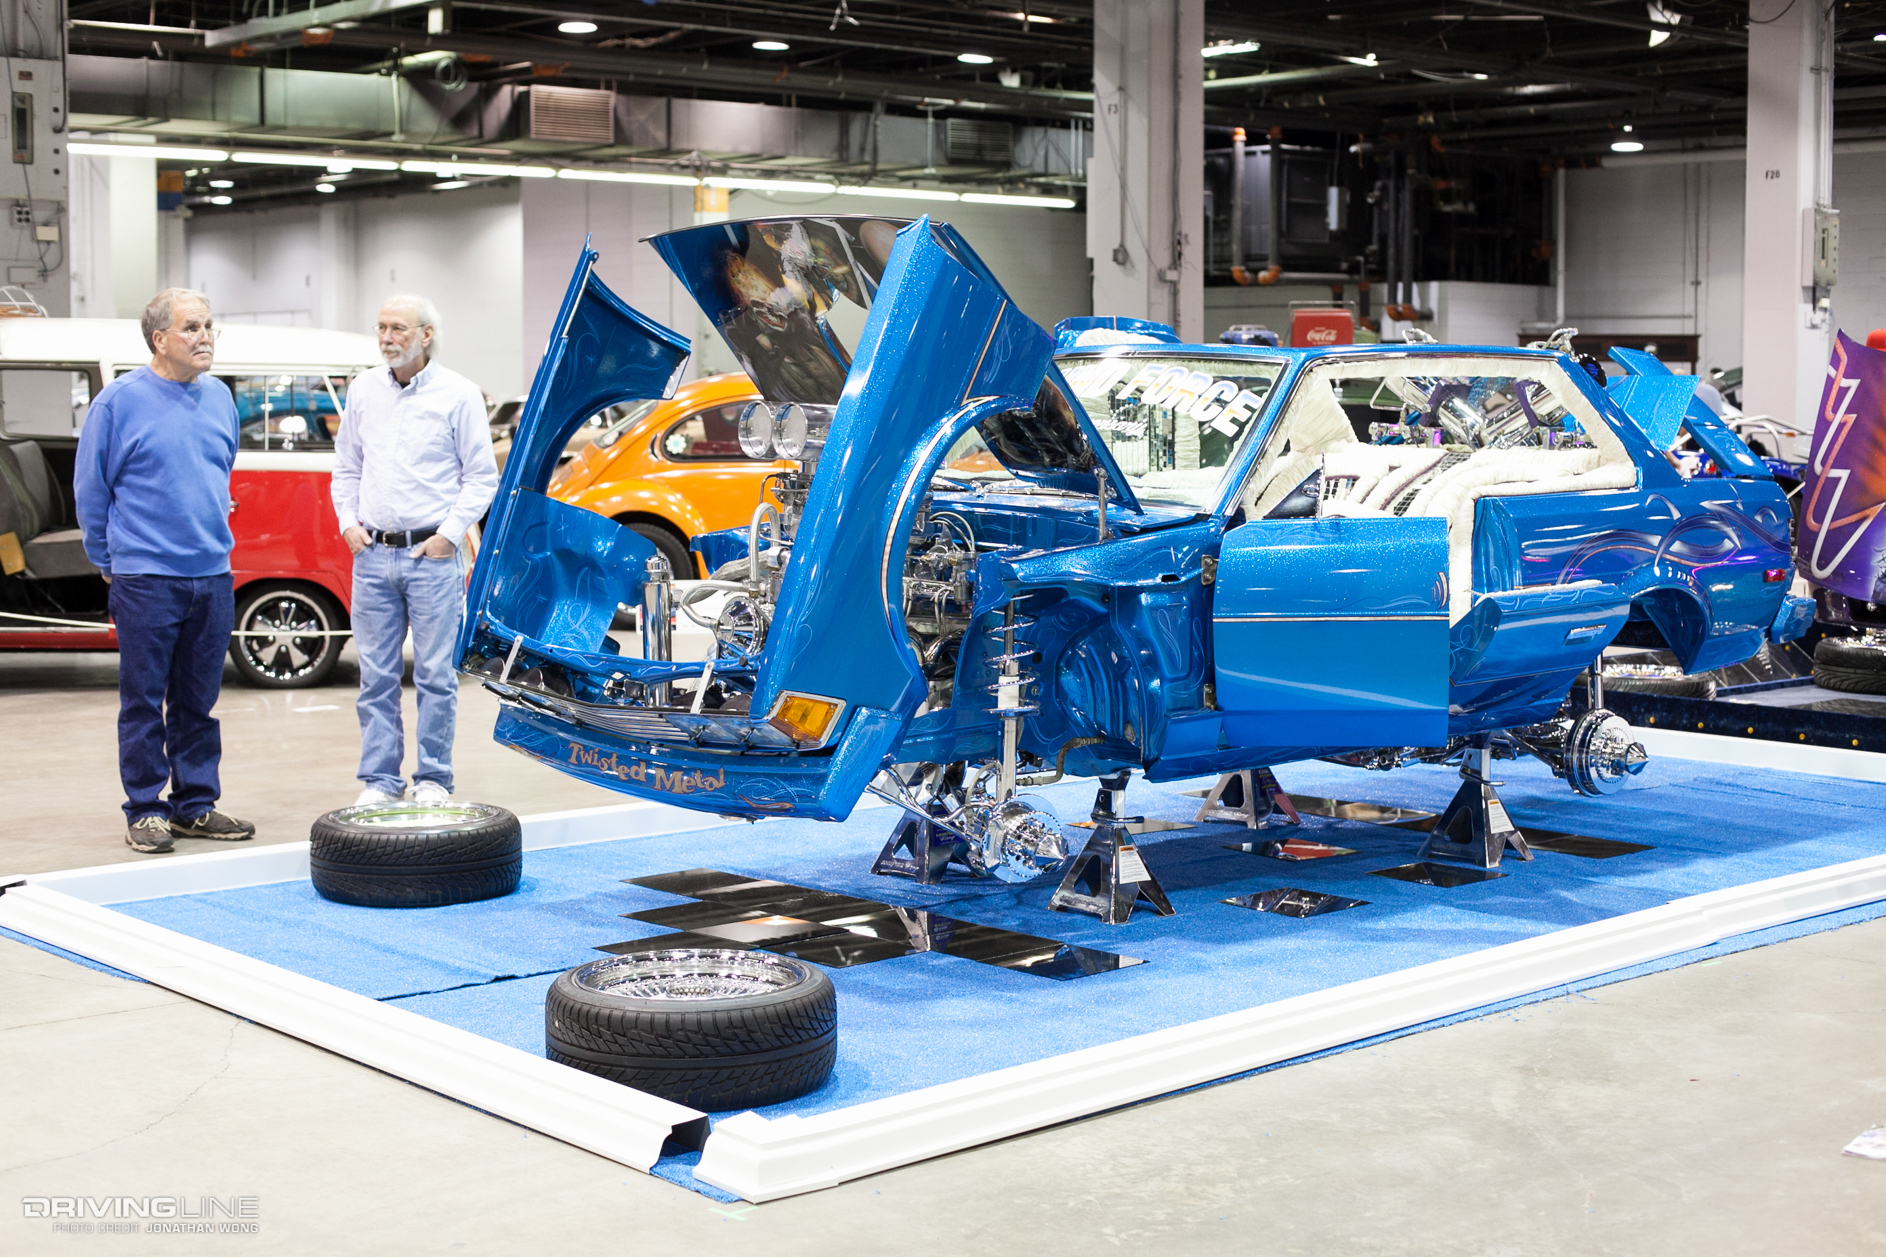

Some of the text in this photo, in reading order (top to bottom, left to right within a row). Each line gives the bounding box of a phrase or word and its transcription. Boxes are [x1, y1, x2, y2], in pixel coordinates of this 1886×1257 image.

[1765, 170, 1781, 180] F20
[1115, 362, 1263, 438] FORCE
[567, 741, 727, 794] Twisted Metal
